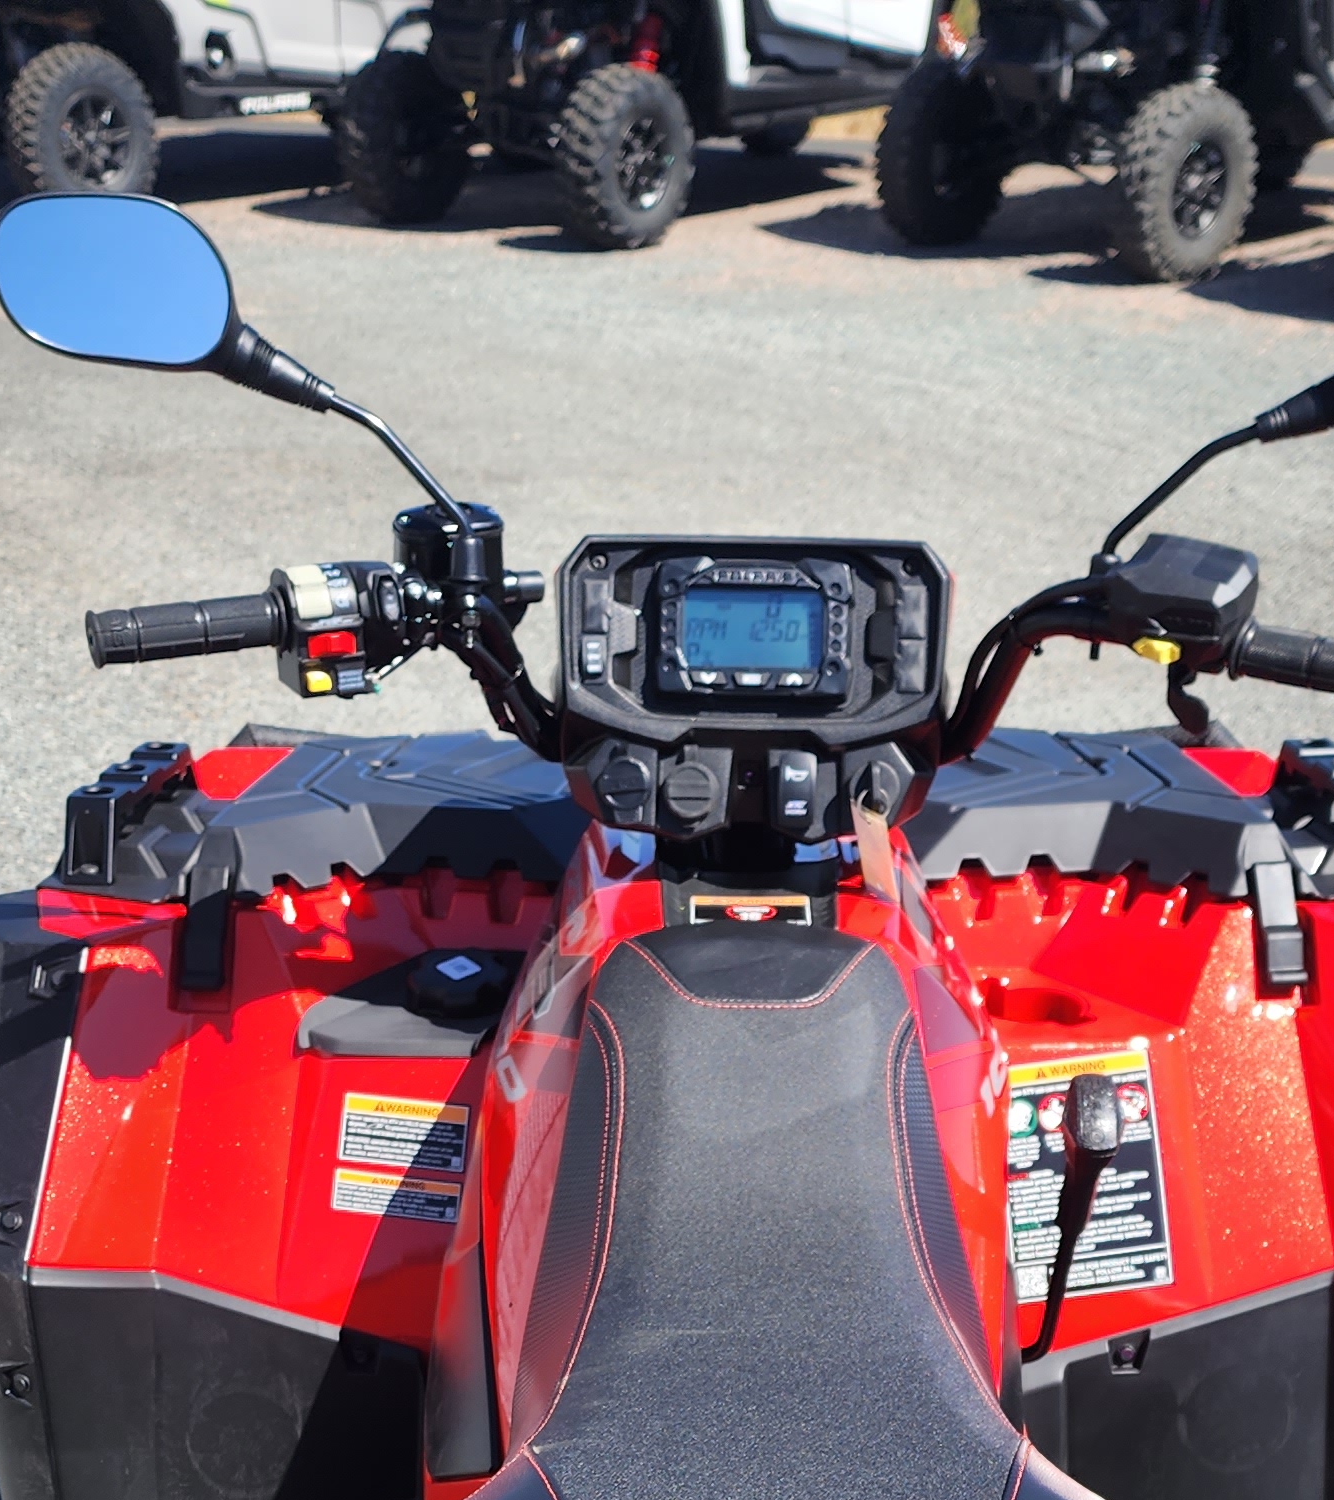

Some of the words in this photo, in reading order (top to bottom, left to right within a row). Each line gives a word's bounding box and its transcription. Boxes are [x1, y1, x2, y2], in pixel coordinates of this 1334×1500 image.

[1049, 1060, 1106, 1077] WARNING
[384, 1104, 440, 1118] WARNING
[380, 1178, 425, 1190] WARNING
